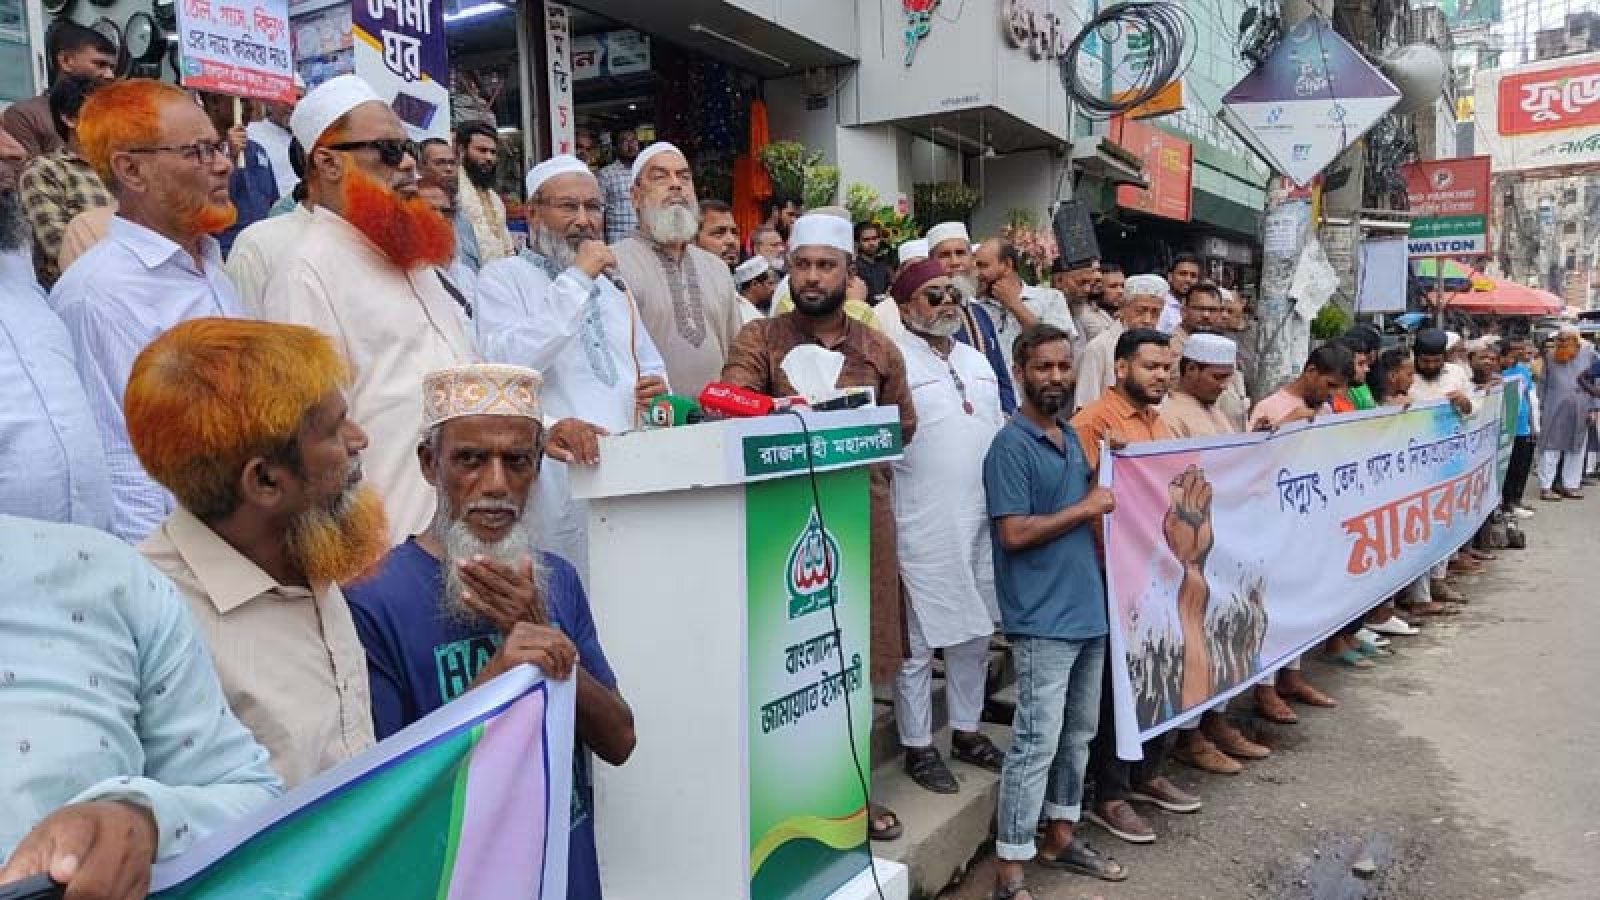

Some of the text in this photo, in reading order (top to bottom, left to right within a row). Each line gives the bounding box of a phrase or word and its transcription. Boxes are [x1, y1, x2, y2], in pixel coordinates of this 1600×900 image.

[381, 29, 422, 80] ঘর
[1408, 239, 1475, 253] WALTON
[758, 434, 827, 464] রাজশহী
